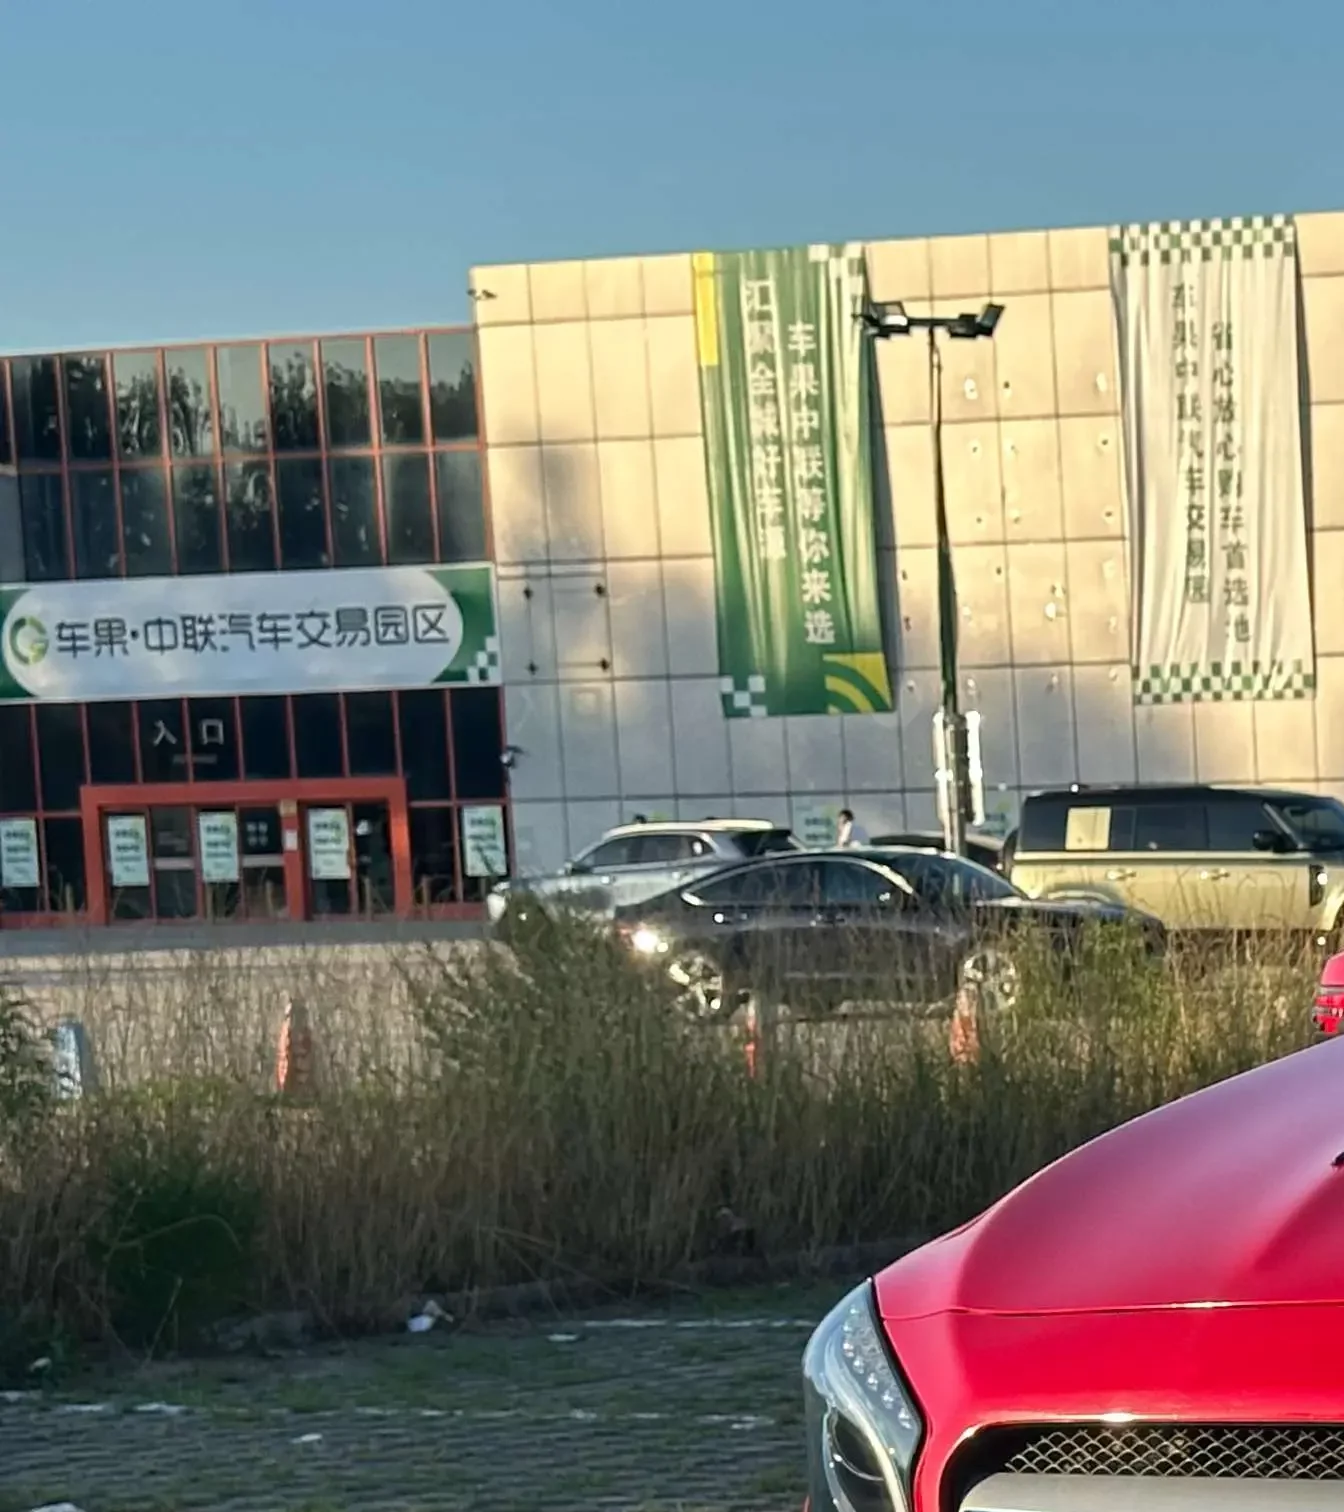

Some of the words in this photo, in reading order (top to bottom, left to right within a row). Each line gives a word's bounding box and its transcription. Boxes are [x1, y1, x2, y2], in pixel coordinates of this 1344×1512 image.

[55, 604, 450, 659] 车果·中联汽车交易园区
[153, 719, 225, 747] 入口
